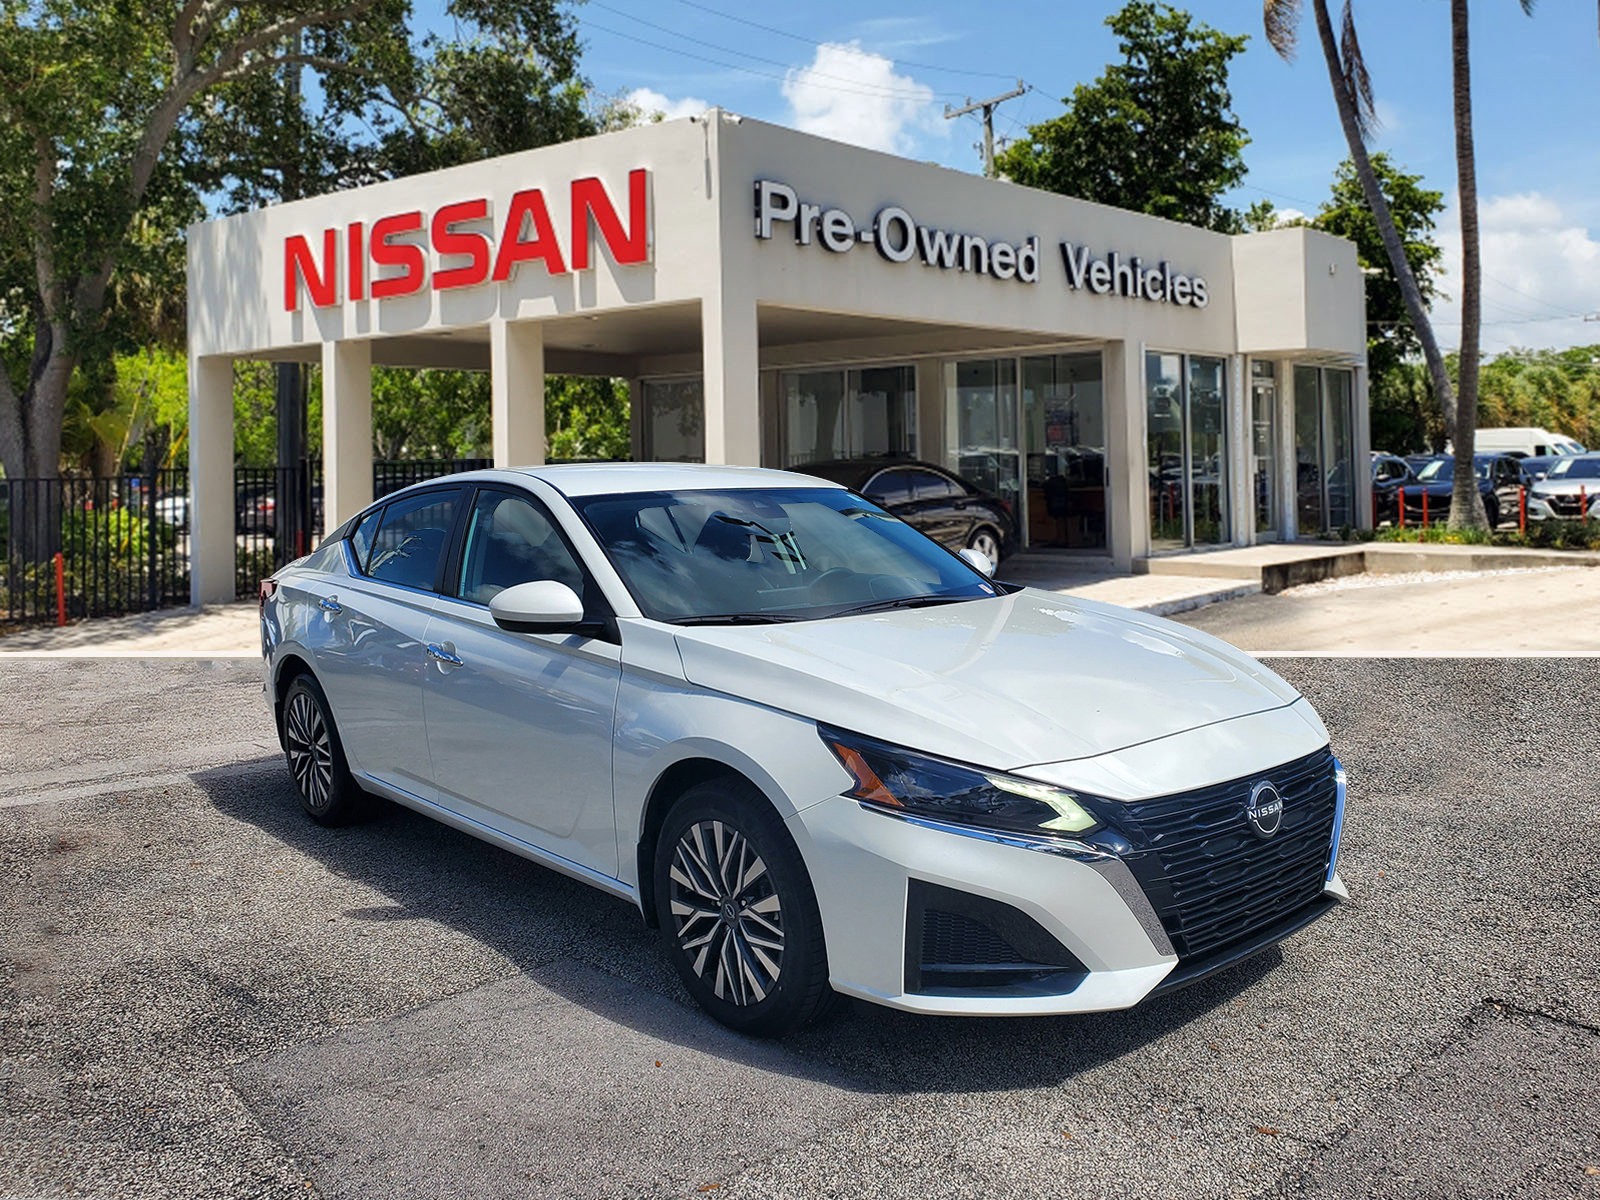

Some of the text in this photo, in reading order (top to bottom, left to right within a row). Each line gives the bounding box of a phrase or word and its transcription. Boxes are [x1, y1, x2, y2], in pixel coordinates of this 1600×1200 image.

[285, 169, 648, 312] NISSAN
[754, 179, 1209, 309] Pre-Owned Vehicles
[1248, 801, 1283, 819] NISSAN
